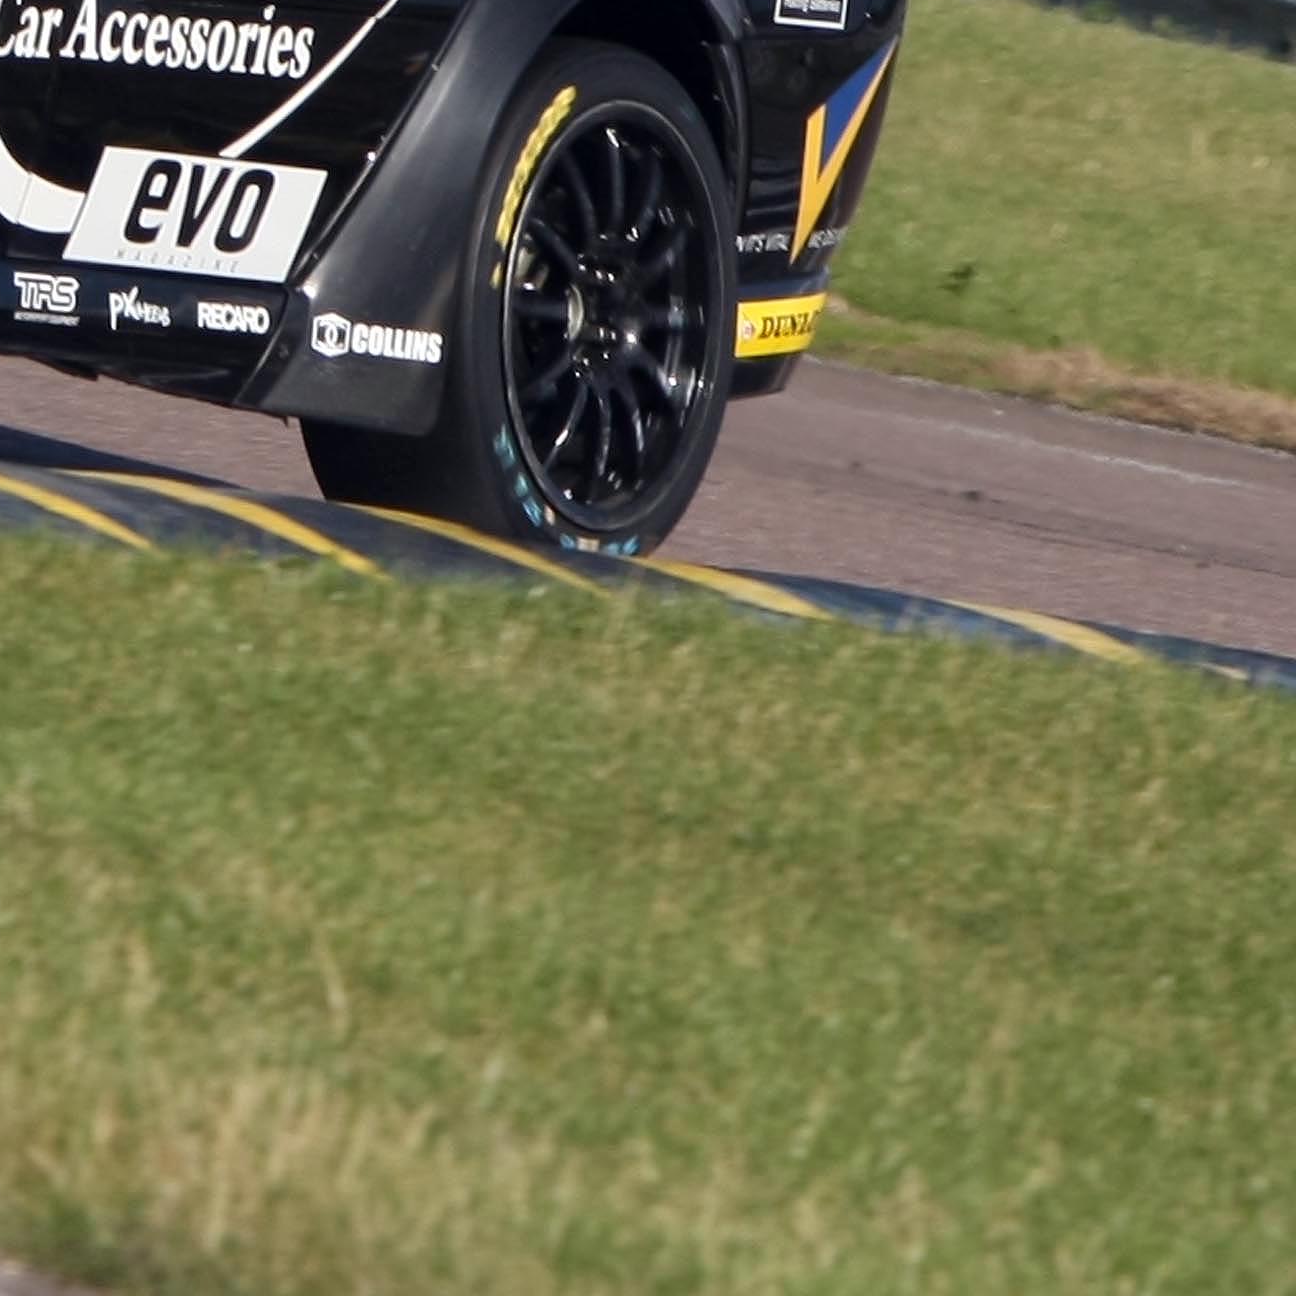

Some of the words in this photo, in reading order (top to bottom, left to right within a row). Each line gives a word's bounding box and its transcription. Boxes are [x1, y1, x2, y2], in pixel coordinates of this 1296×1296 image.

[123, 158, 276, 254] evo
[13, 271, 81, 313] TRS
[196, 301, 271, 335] RECARO
[351, 322, 444, 364] COLLINS
